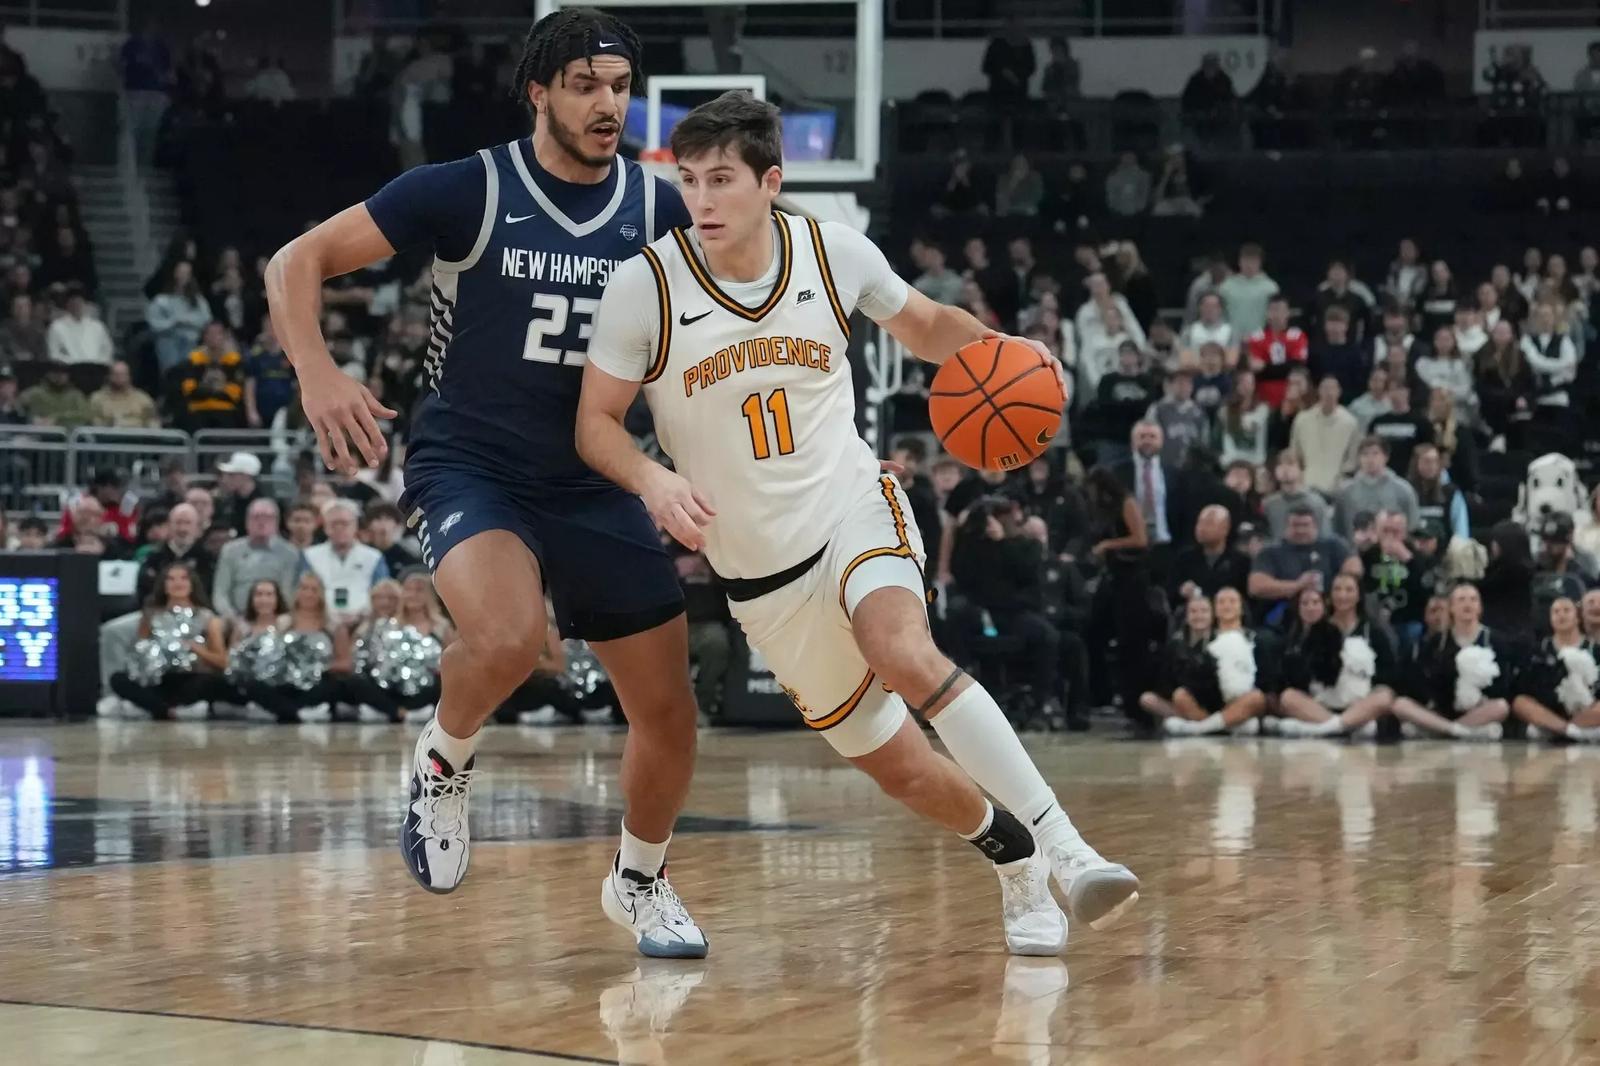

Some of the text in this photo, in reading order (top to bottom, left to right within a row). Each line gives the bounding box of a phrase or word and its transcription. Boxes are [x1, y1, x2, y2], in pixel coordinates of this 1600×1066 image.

[501, 246, 622, 287] NEW HAMPSH
[522, 292, 601, 367] 23
[683, 336, 831, 398] PROVIDENCE
[741, 387, 795, 460] 11
